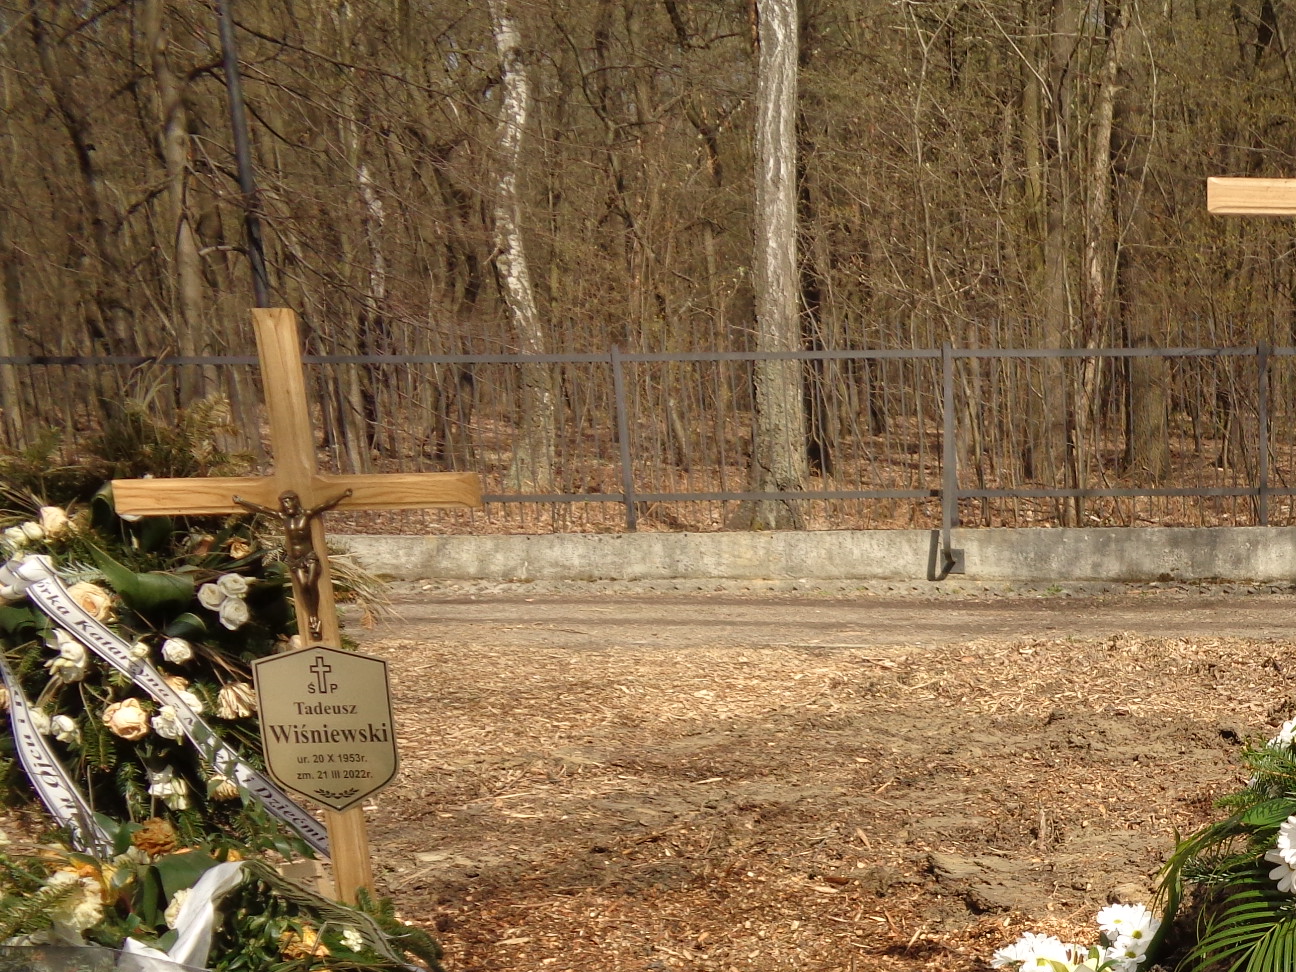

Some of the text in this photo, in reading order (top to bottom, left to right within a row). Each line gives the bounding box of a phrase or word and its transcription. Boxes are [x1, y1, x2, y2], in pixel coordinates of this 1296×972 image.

[293, 701, 359, 716] Tadeusz
[269, 722, 389, 745] Wiśniewski
[297, 753, 368, 765] ur. 20 X 1953r.
[297, 769, 373, 781] zm. 21 III 2022r.
[254, 787, 329, 842] Dziećmi
